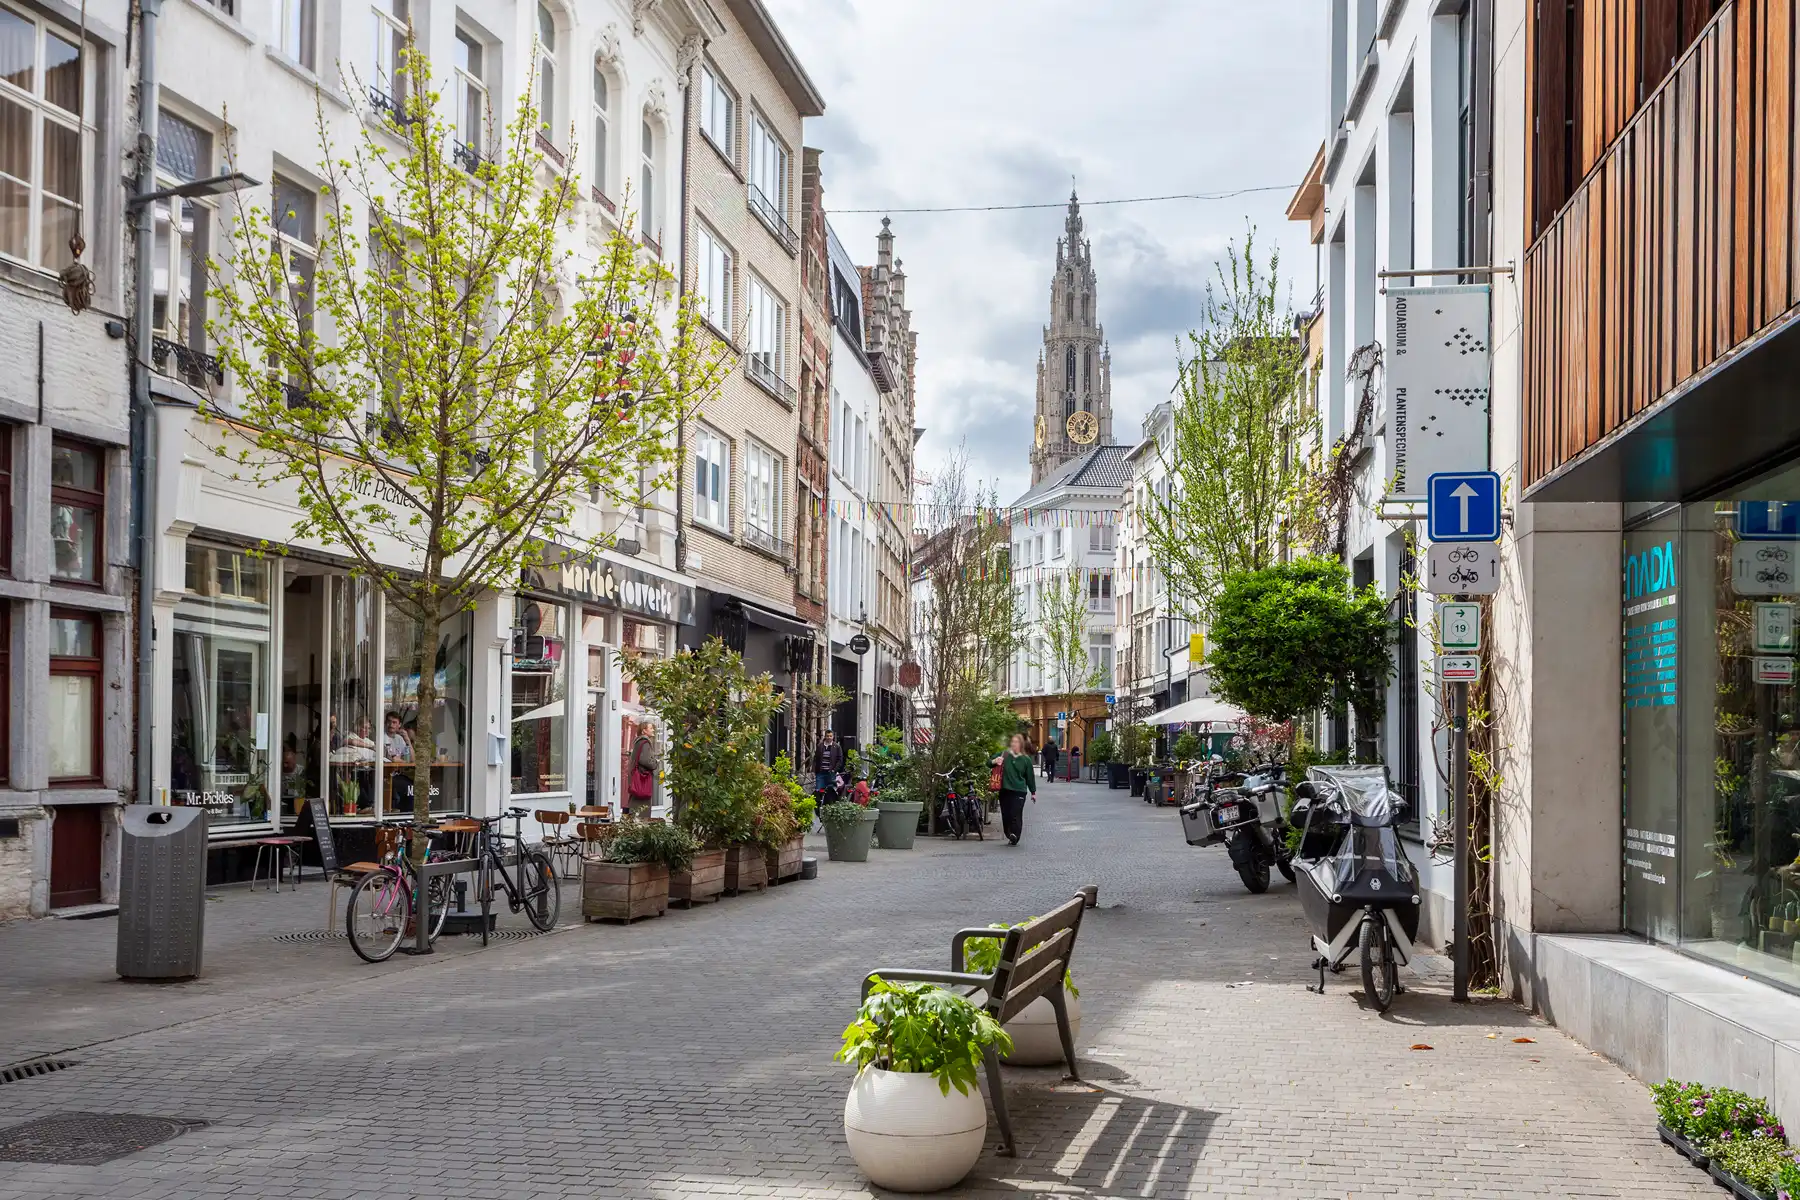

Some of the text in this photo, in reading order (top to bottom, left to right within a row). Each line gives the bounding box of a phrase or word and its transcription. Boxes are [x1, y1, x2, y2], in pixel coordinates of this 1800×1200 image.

[1396, 297, 1407, 347] AQUARIUM
[349, 471, 418, 509] Mr. Pickles
[1455, 624, 1466, 633] 19
[491, 714, 495, 724] 9
[186, 790, 234, 806] Mr. Pickles
